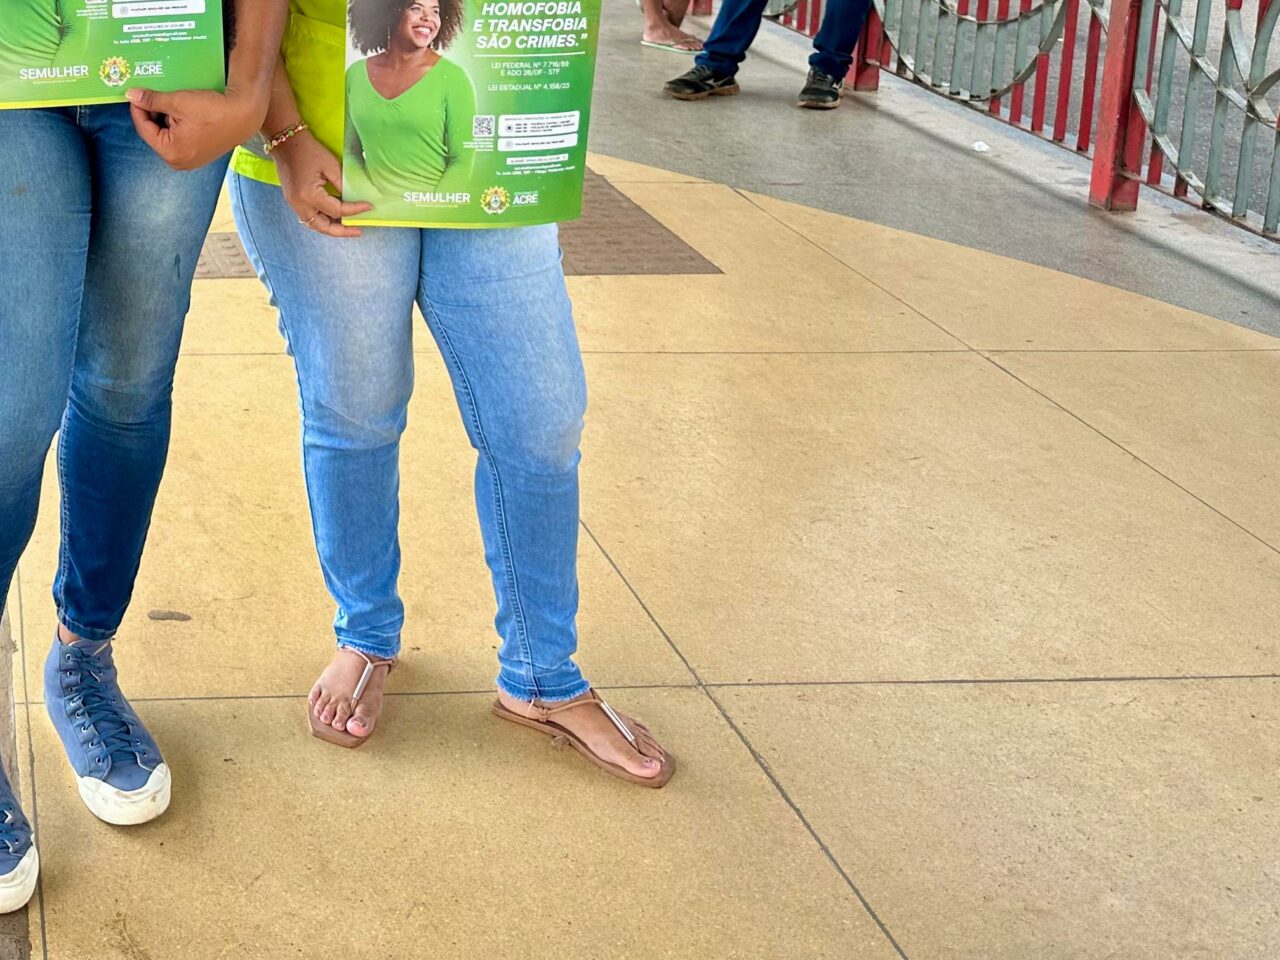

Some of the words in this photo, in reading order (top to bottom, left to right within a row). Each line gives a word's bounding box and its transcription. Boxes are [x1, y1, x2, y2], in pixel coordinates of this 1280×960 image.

[482, 1, 581, 16] HOMOFOBIA
[473, 19, 483, 32] E
[488, 17, 587, 32] TRANSFOBIA
[476, 32, 512, 49] SÃO
[515, 33, 588, 48] CRIMES.”
[134, 64, 163, 76] ACRE
[502, 61, 532, 69] FEDERAL
[20, 65, 88, 80] SEMULHER
[403, 192, 470, 203] SEMULHER
[513, 194, 538, 205] ACRE
